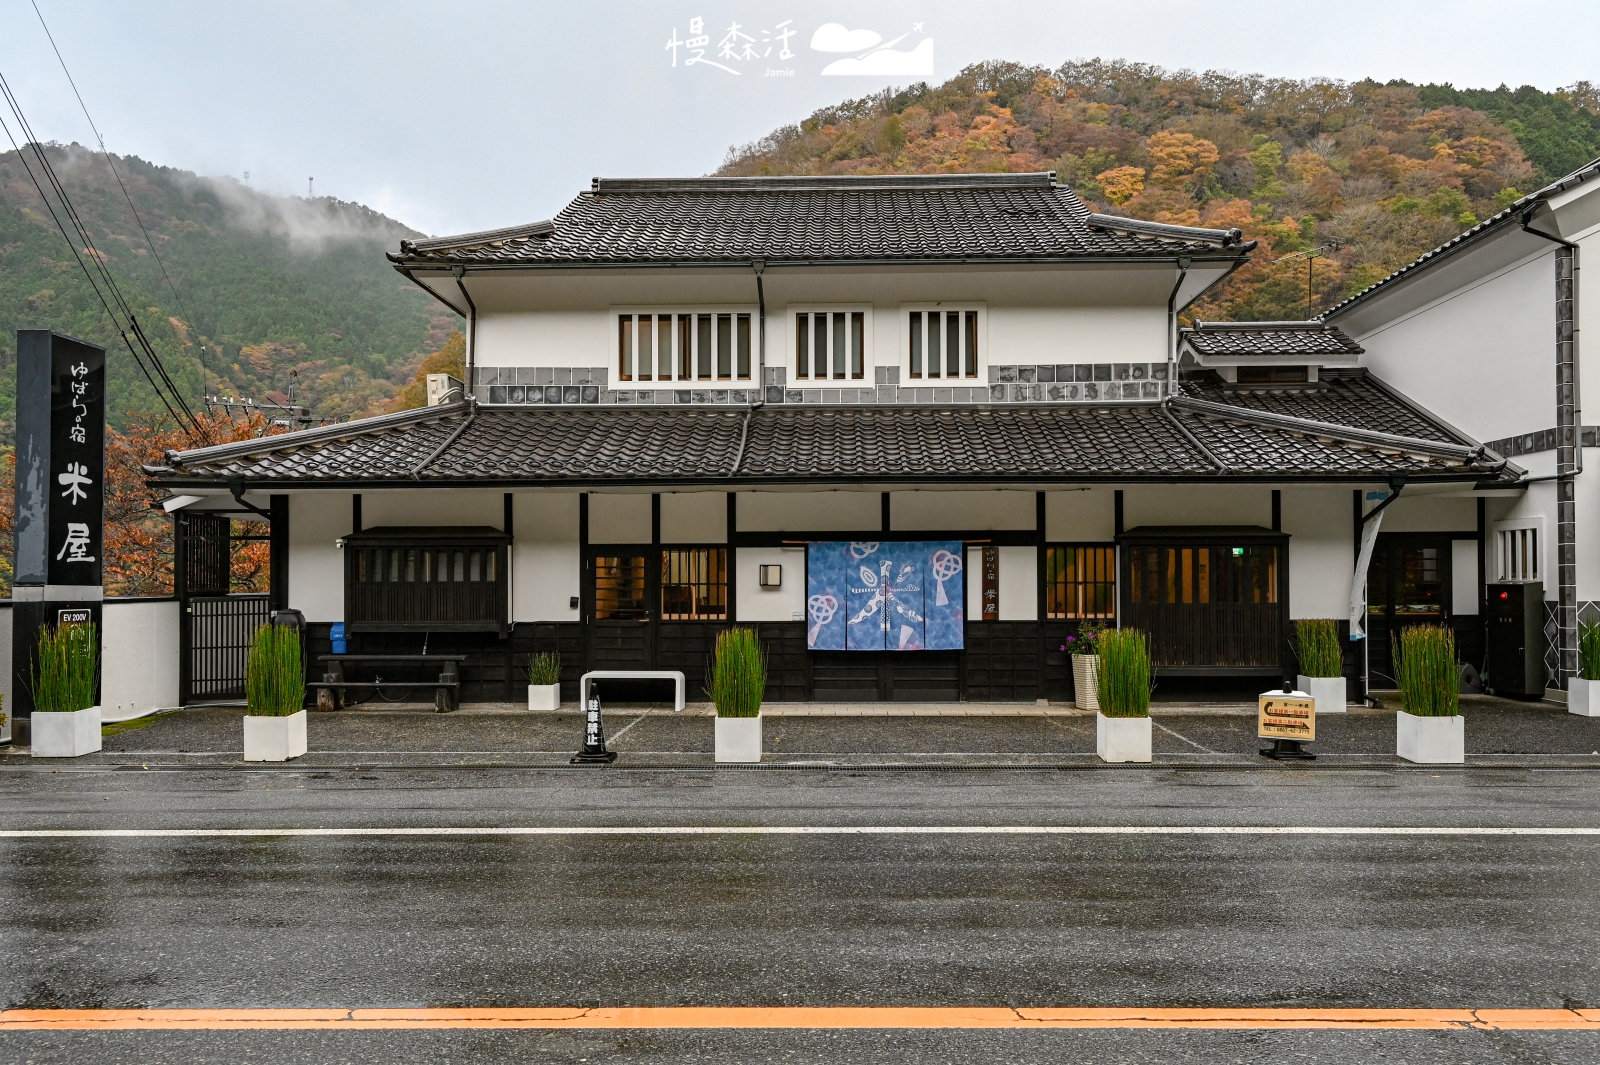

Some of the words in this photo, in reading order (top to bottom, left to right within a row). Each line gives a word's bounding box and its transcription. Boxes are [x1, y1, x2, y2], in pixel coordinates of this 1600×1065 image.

[69, 361, 89, 444] ゆばらの宿
[56, 461, 96, 564] 米屋
[63, 613, 72, 622] EV
[72, 613, 87, 622] 200V
[587, 699, 599, 745] 駐車禁止
